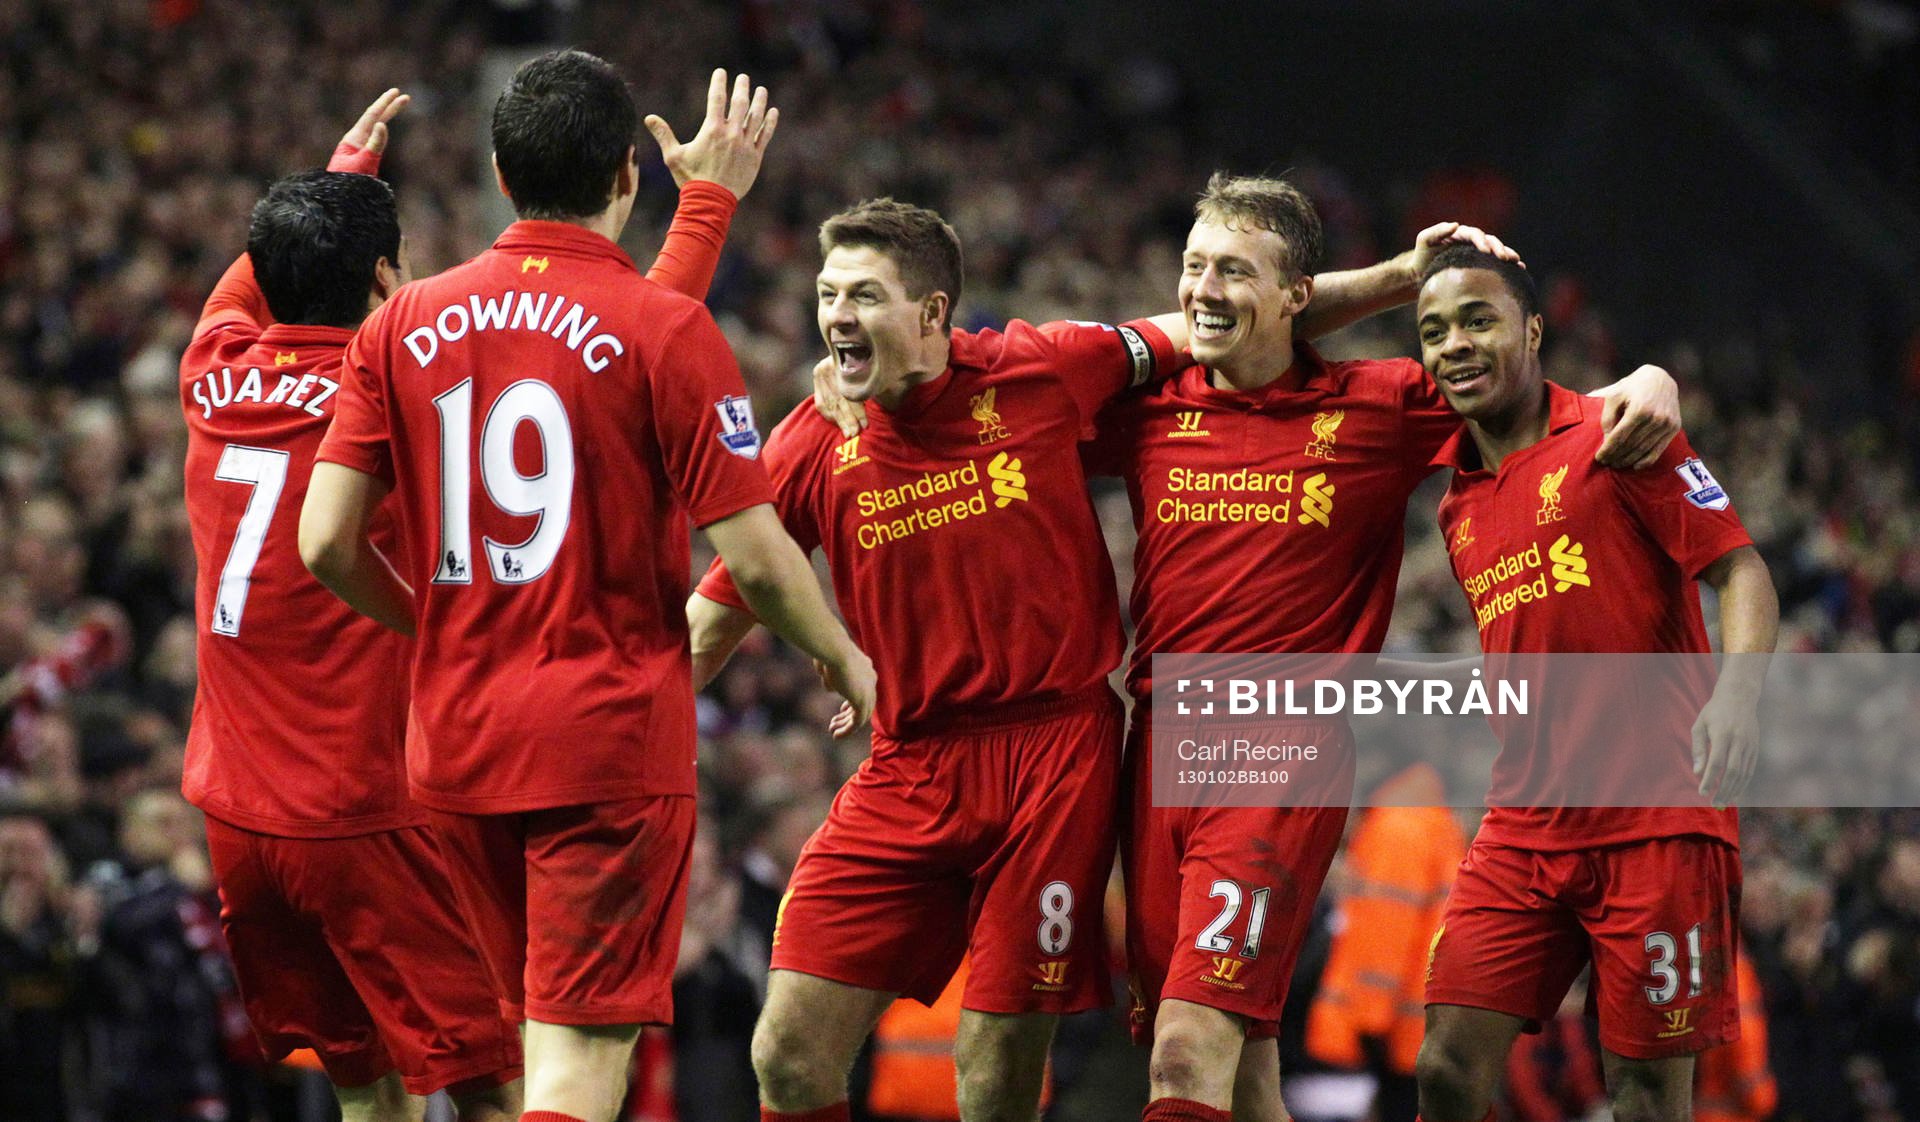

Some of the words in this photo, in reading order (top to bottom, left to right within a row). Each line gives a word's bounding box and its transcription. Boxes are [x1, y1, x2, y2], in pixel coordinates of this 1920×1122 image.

[402, 289, 624, 374] DOWNING
[192, 366, 341, 420] SUAREZ
[431, 376, 575, 585] 19
[856, 460, 980, 518] Standard
[1167, 467, 1293, 495] Standard
[213, 443, 291, 637] 7
[857, 489, 987, 550] Chartered
[1157, 499, 1290, 524] Chartered
[1464, 541, 1542, 602] Standard
[1475, 572, 1548, 632] hartered
[1037, 880, 1075, 957] 8
[1194, 878, 1271, 961] 21
[1644, 922, 1703, 1006] 31
